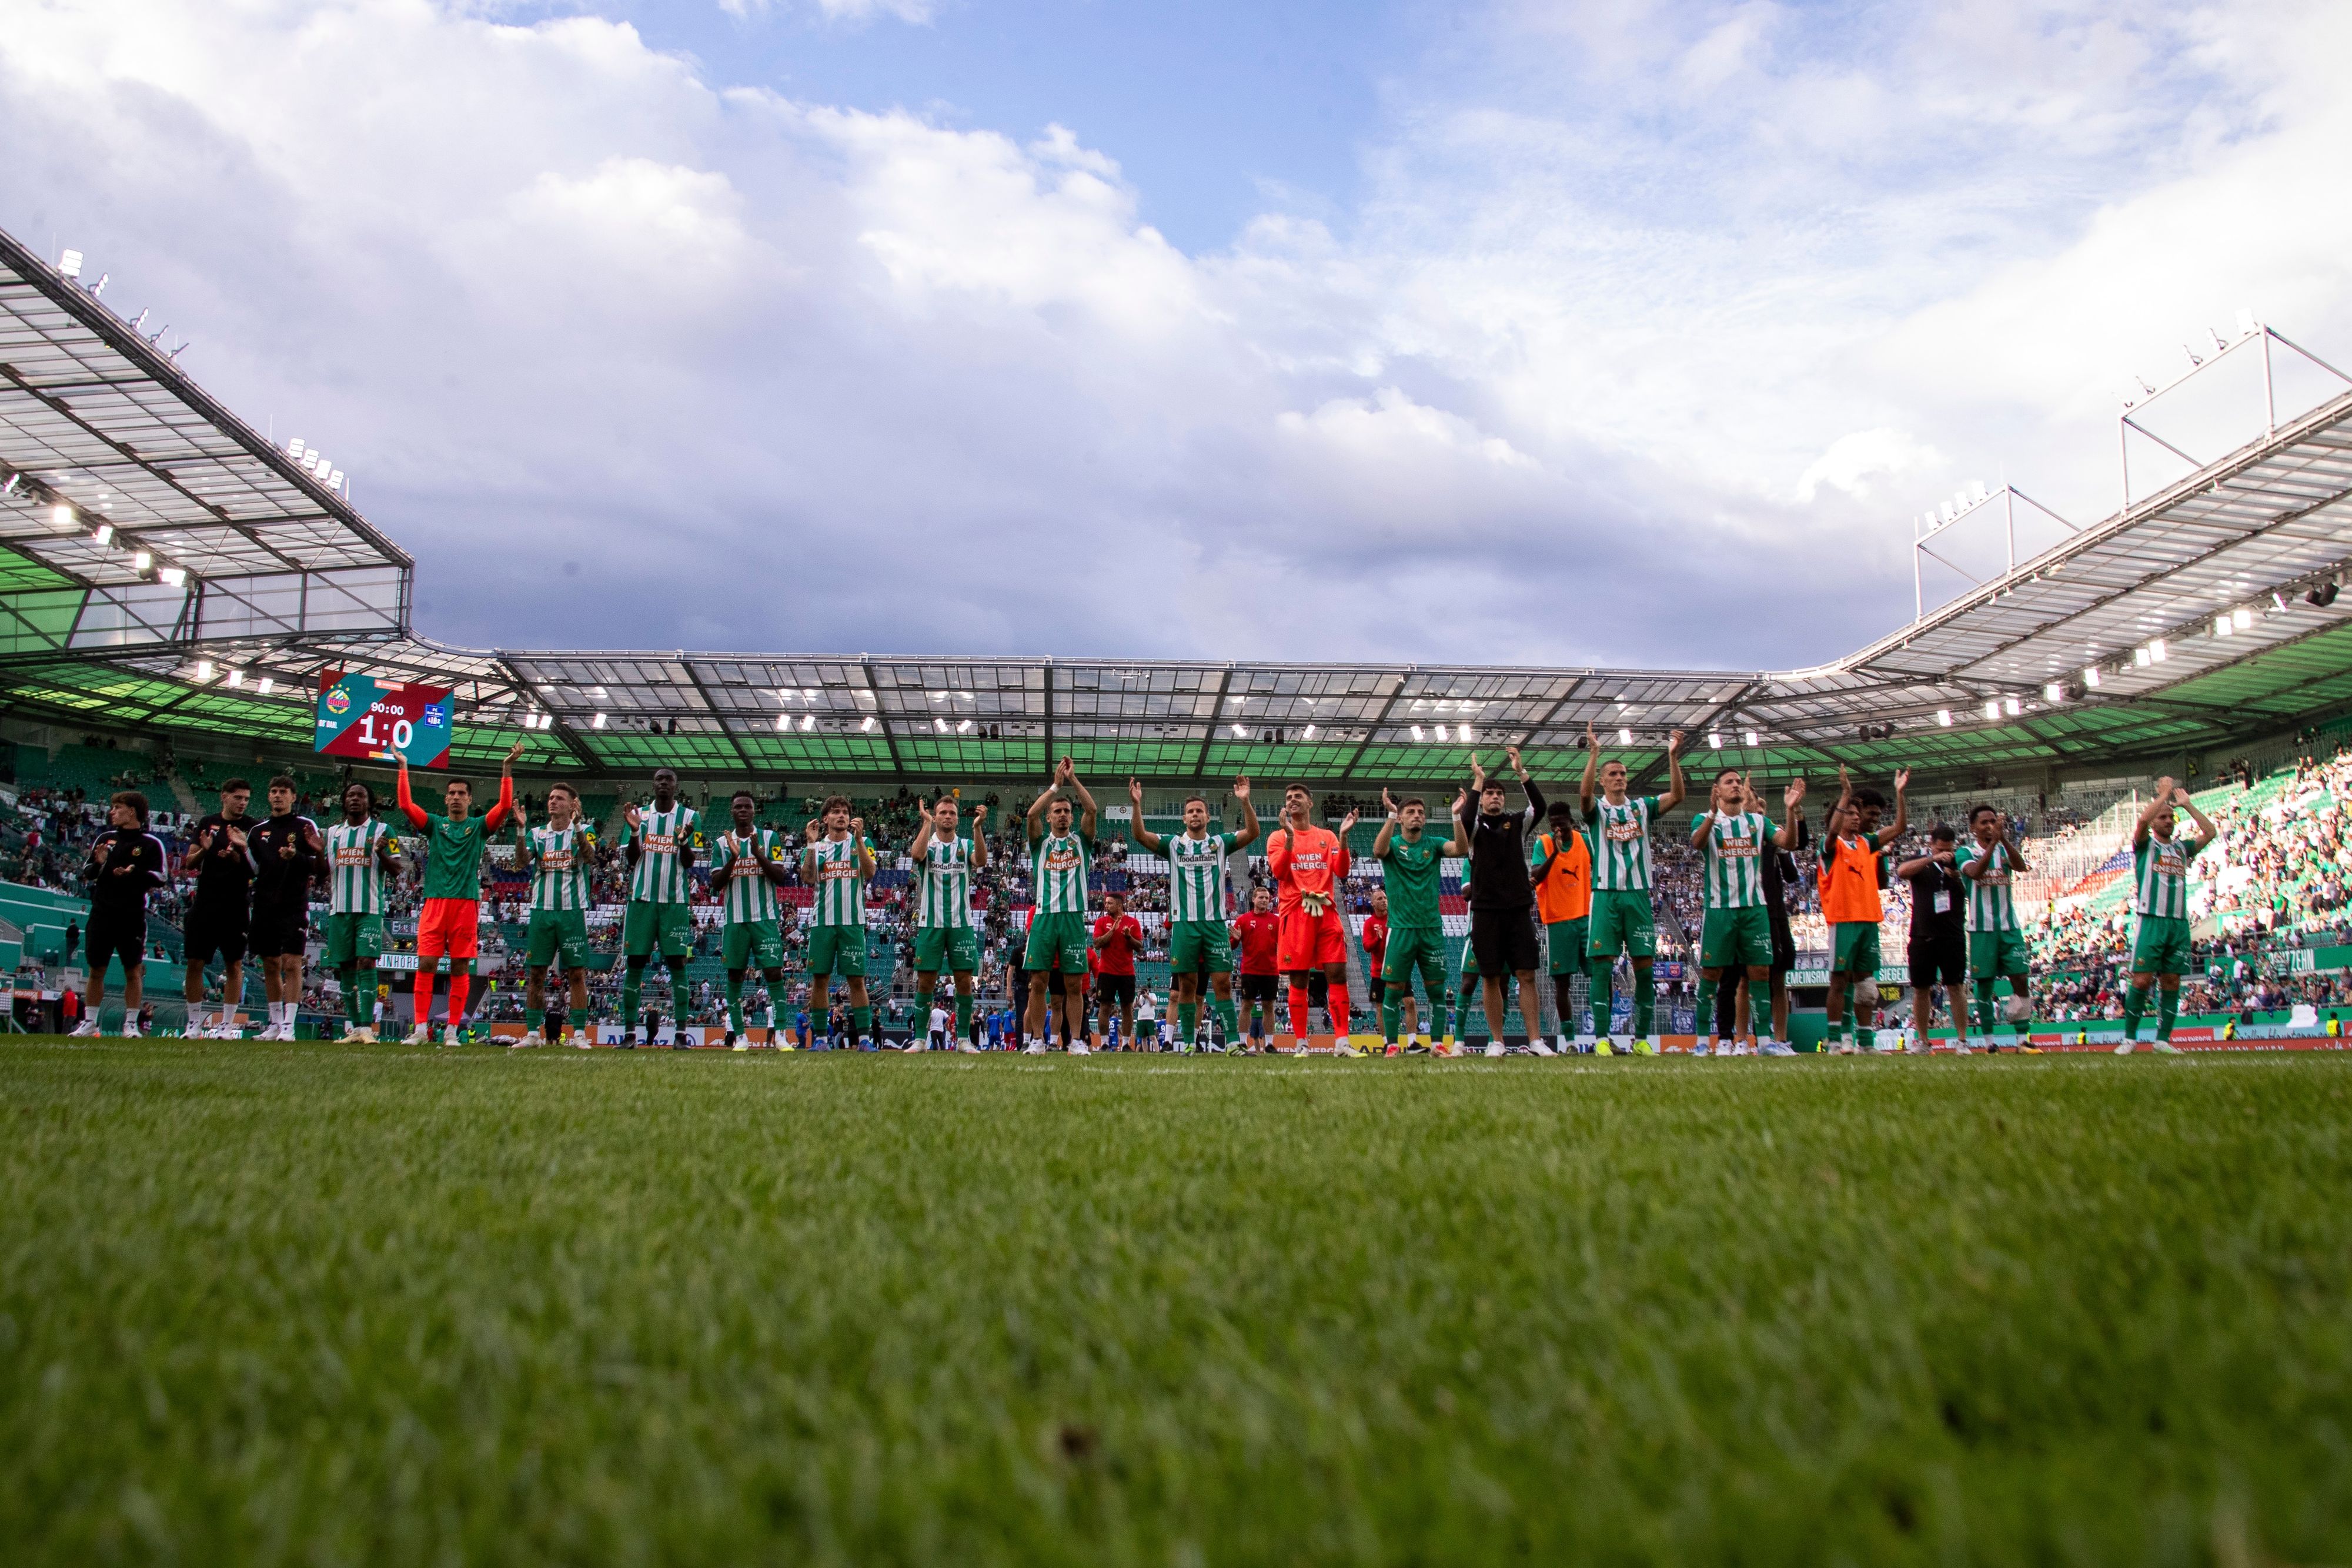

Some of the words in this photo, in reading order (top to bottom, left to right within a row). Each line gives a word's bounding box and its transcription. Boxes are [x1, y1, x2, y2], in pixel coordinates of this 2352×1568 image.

[371, 702, 404, 716] 90:00
[358, 714, 413, 749] 1:0
[649, 835, 673, 844] WIEN
[1724, 838, 1750, 847] WIEN
[643, 844, 677, 852] ENERGIE
[1718, 847, 1758, 857] ENERGIE
[1052, 851, 1073, 861] WIEN
[1178, 854, 1216, 862] foodaffairs
[1297, 853, 1322, 861] WIEN
[336, 857, 370, 866] ENERGIE
[541, 859, 577, 868] ENERGIE
[826, 862, 850, 870] WIEN
[928, 861, 964, 870] foodaffairs
[1045, 857, 1081, 869] ENERGIE
[1291, 862, 1328, 870] ENERGIE
[820, 870, 857, 880] ENERGIE
[1785, 971, 1830, 985] EMEINSAM
